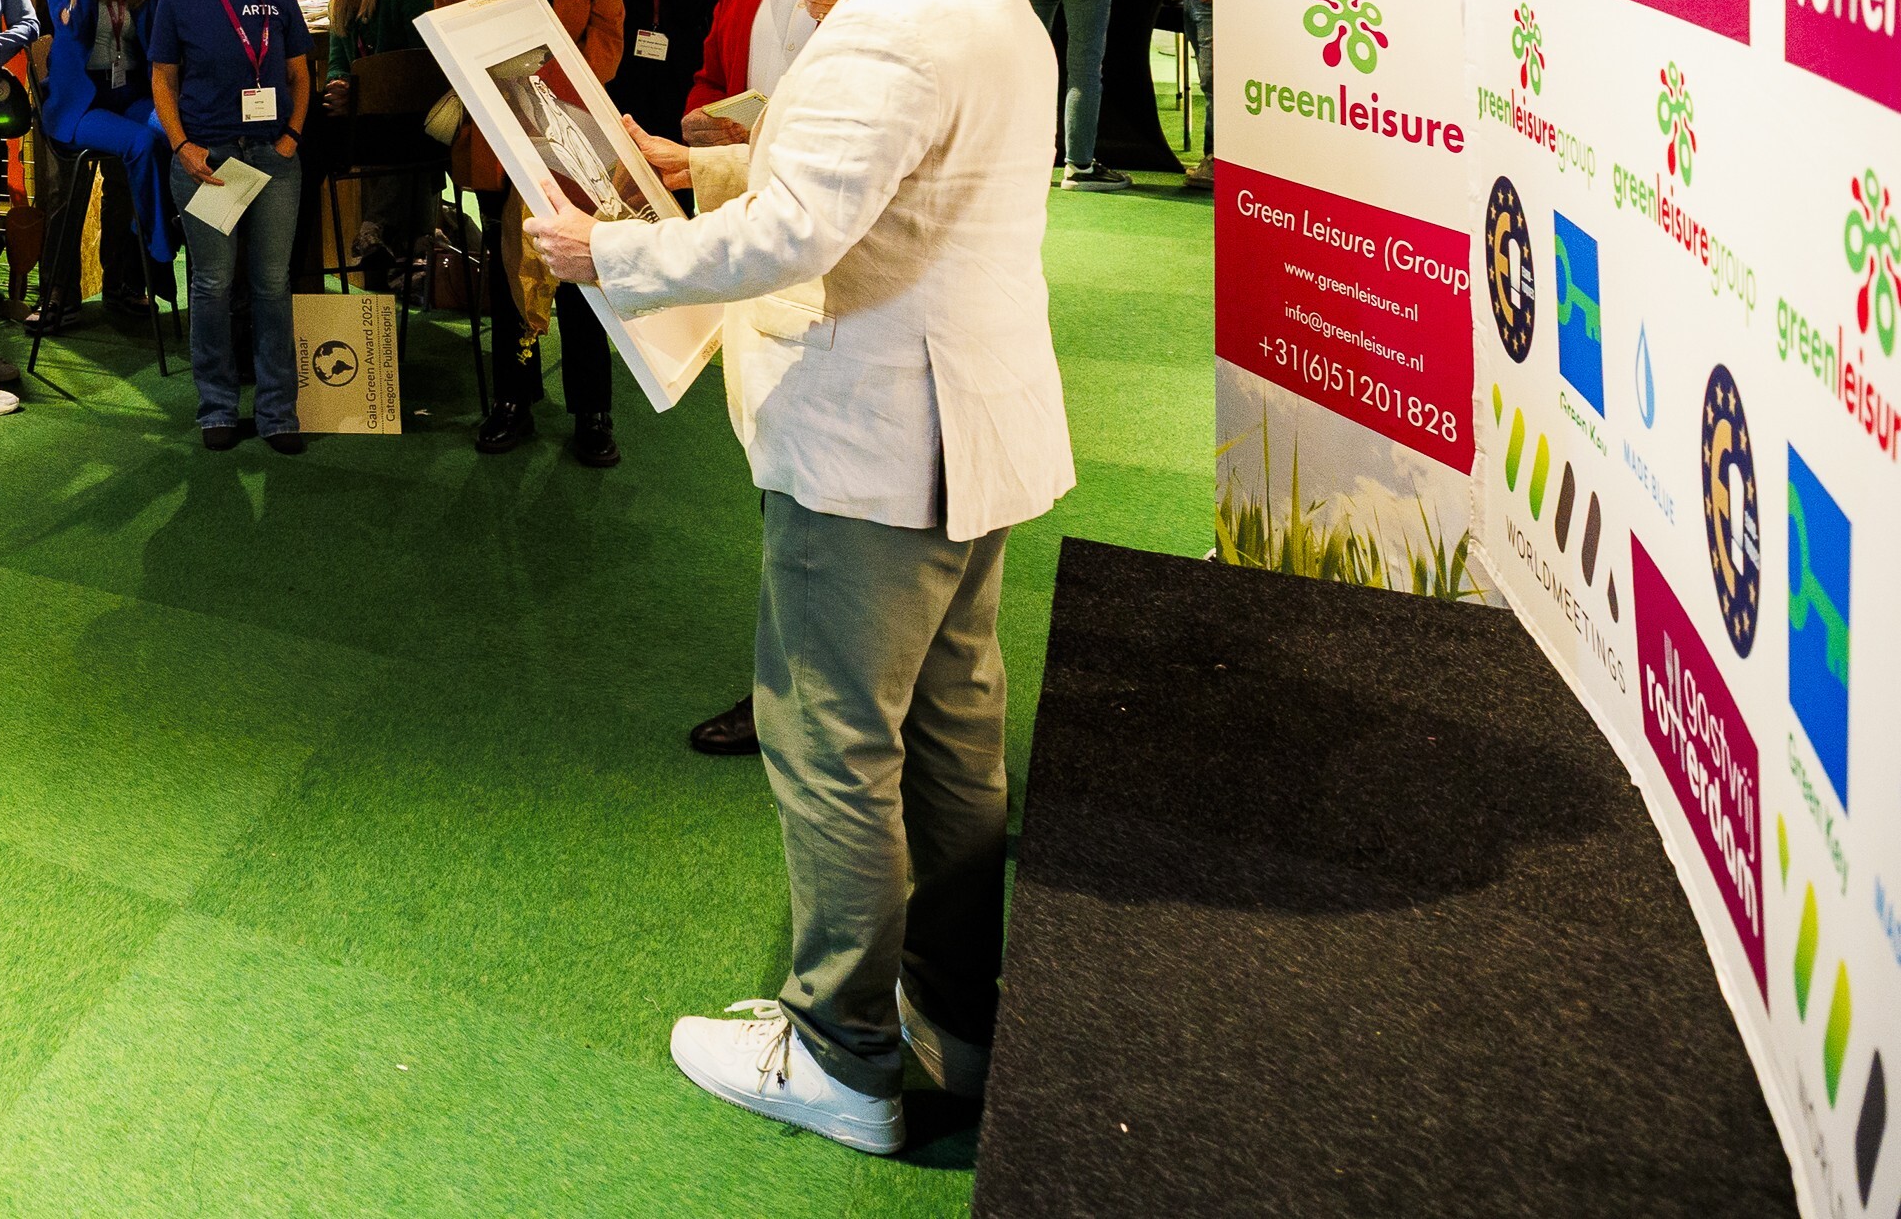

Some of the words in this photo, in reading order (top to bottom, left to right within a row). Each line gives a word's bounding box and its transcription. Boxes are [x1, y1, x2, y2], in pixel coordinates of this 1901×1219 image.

[241, 4, 280, 16] ARTIS
[1244, 78, 1466, 154] greenleisure
[1236, 189, 1296, 234] Green
[1302, 207, 1377, 259] Leisure
[1383, 233, 1471, 298] (Group
[1613, 162, 1758, 329] greenleisuregroup
[361, 298, 373, 327] 2025
[1283, 260, 1419, 323] www.greenleisure.nl
[298, 336, 310, 390] Winnaar
[364, 329, 375, 366] Award
[381, 305, 394, 368] Publieksprijs
[1284, 301, 1425, 375] info@greenleisure.nl
[365, 367, 377, 403] Green
[385, 370, 397, 423] Categorie:
[1258, 335, 1459, 445] +31(6)51201828
[1559, 390, 1588, 436] Green
[366, 404, 378, 430] Gaia
[1623, 437, 1649, 491] MADE
[1651, 472, 1675, 527] BLUE
[1505, 514, 1626, 695] WORLDMEETINGS
[1683, 668, 1756, 864] gastvrij
[1645, 663, 1760, 938] rotterdam
